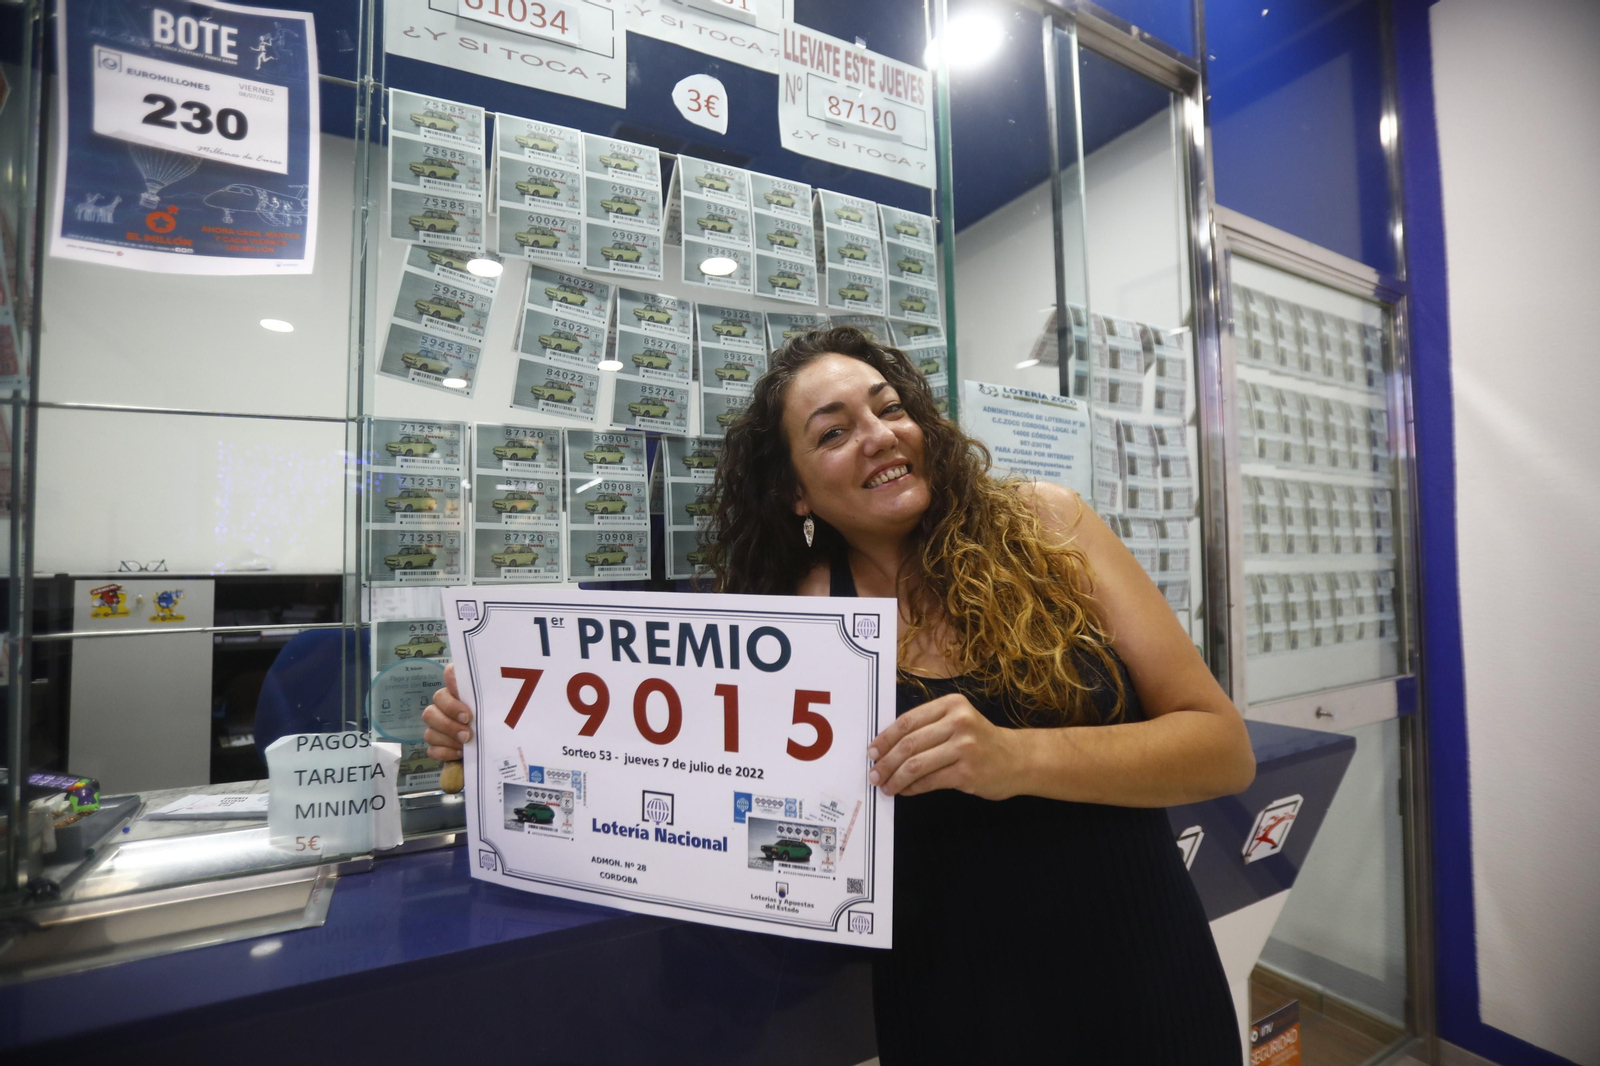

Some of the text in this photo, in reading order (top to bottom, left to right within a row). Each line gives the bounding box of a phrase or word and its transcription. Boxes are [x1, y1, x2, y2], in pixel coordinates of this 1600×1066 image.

[153, 8, 238, 60] BOTE
[660, 14, 683, 29] SI
[693, 23, 763, 54] TOCA
[403, 26, 612, 84] ¿Y SI TOCA ?
[783, 27, 926, 105] LLEVATE ESTE JUEVES
[126, 67, 211, 91] EUROMILLONES
[238, 83, 275, 96] VIERNES
[423, 100, 465, 115] 75585
[687, 88, 720, 118] 3€
[141, 93, 249, 141] 230
[828, 95, 897, 131] 87120
[526, 123, 563, 136] 60067
[197, 144, 283, 165] Millones de Euros
[423, 146, 465, 161] 75585
[792, 130, 820, 141] ¿Y
[827, 137, 847, 149] SI
[853, 143, 911, 167] TOCA
[527, 165, 565, 179] 60067
[611, 184, 646, 198] 69037
[423, 197, 465, 211] 75585
[706, 203, 737, 216] 83436
[527, 214, 565, 227] 60067
[126, 232, 142, 241] EL
[612, 230, 647, 243] 69037
[558, 274, 594, 290] 84022
[433, 283, 475, 302] 59453
[720, 309, 750, 319] 89324
[553, 318, 590, 334] 84022
[420, 335, 463, 354] 59453
[643, 337, 677, 350] 85274
[724, 352, 753, 362] 89324
[546, 367, 584, 383] 84022
[640, 385, 675, 398] 85274
[1003, 387, 1077, 406] LOTERÍA ZOCO
[983, 406, 1035, 419] ADMINISTRACIÓN
[400, 424, 442, 433] 71251
[505, 429, 544, 438] 87120
[594, 435, 629, 443] 30908
[995, 446, 1011, 454] PARA
[400, 477, 442, 486] 71251
[597, 483, 631, 491] 30908
[400, 534, 442, 542] 71251
[505, 533, 544, 542] 87120
[577, 617, 792, 673] PREMIO
[390, 675, 403, 683] Paga
[386, 683, 409, 691] premios
[297, 733, 371, 752] PAGOS
[562, 746, 596, 759] Sorteo
[599, 750, 612, 761] 53
[624, 753, 659, 767] jueves
[662, 757, 669, 768] 7
[672, 758, 686, 770] de
[689, 760, 714, 773] julio
[717, 764, 732, 776] de
[735, 766, 764, 780] 2022
[294, 763, 386, 786] TARJETA
[295, 795, 386, 819] MINIMO
[592, 818, 728, 853] Lotería Nacional
[295, 836, 321, 851] 5€
[591, 856, 623, 868] ADMON.
[636, 863, 647, 872] 28
[600, 871, 638, 884] CORDOBA
[777, 905, 799, 914] Estado
[784, 899, 814, 909] Apuestas
